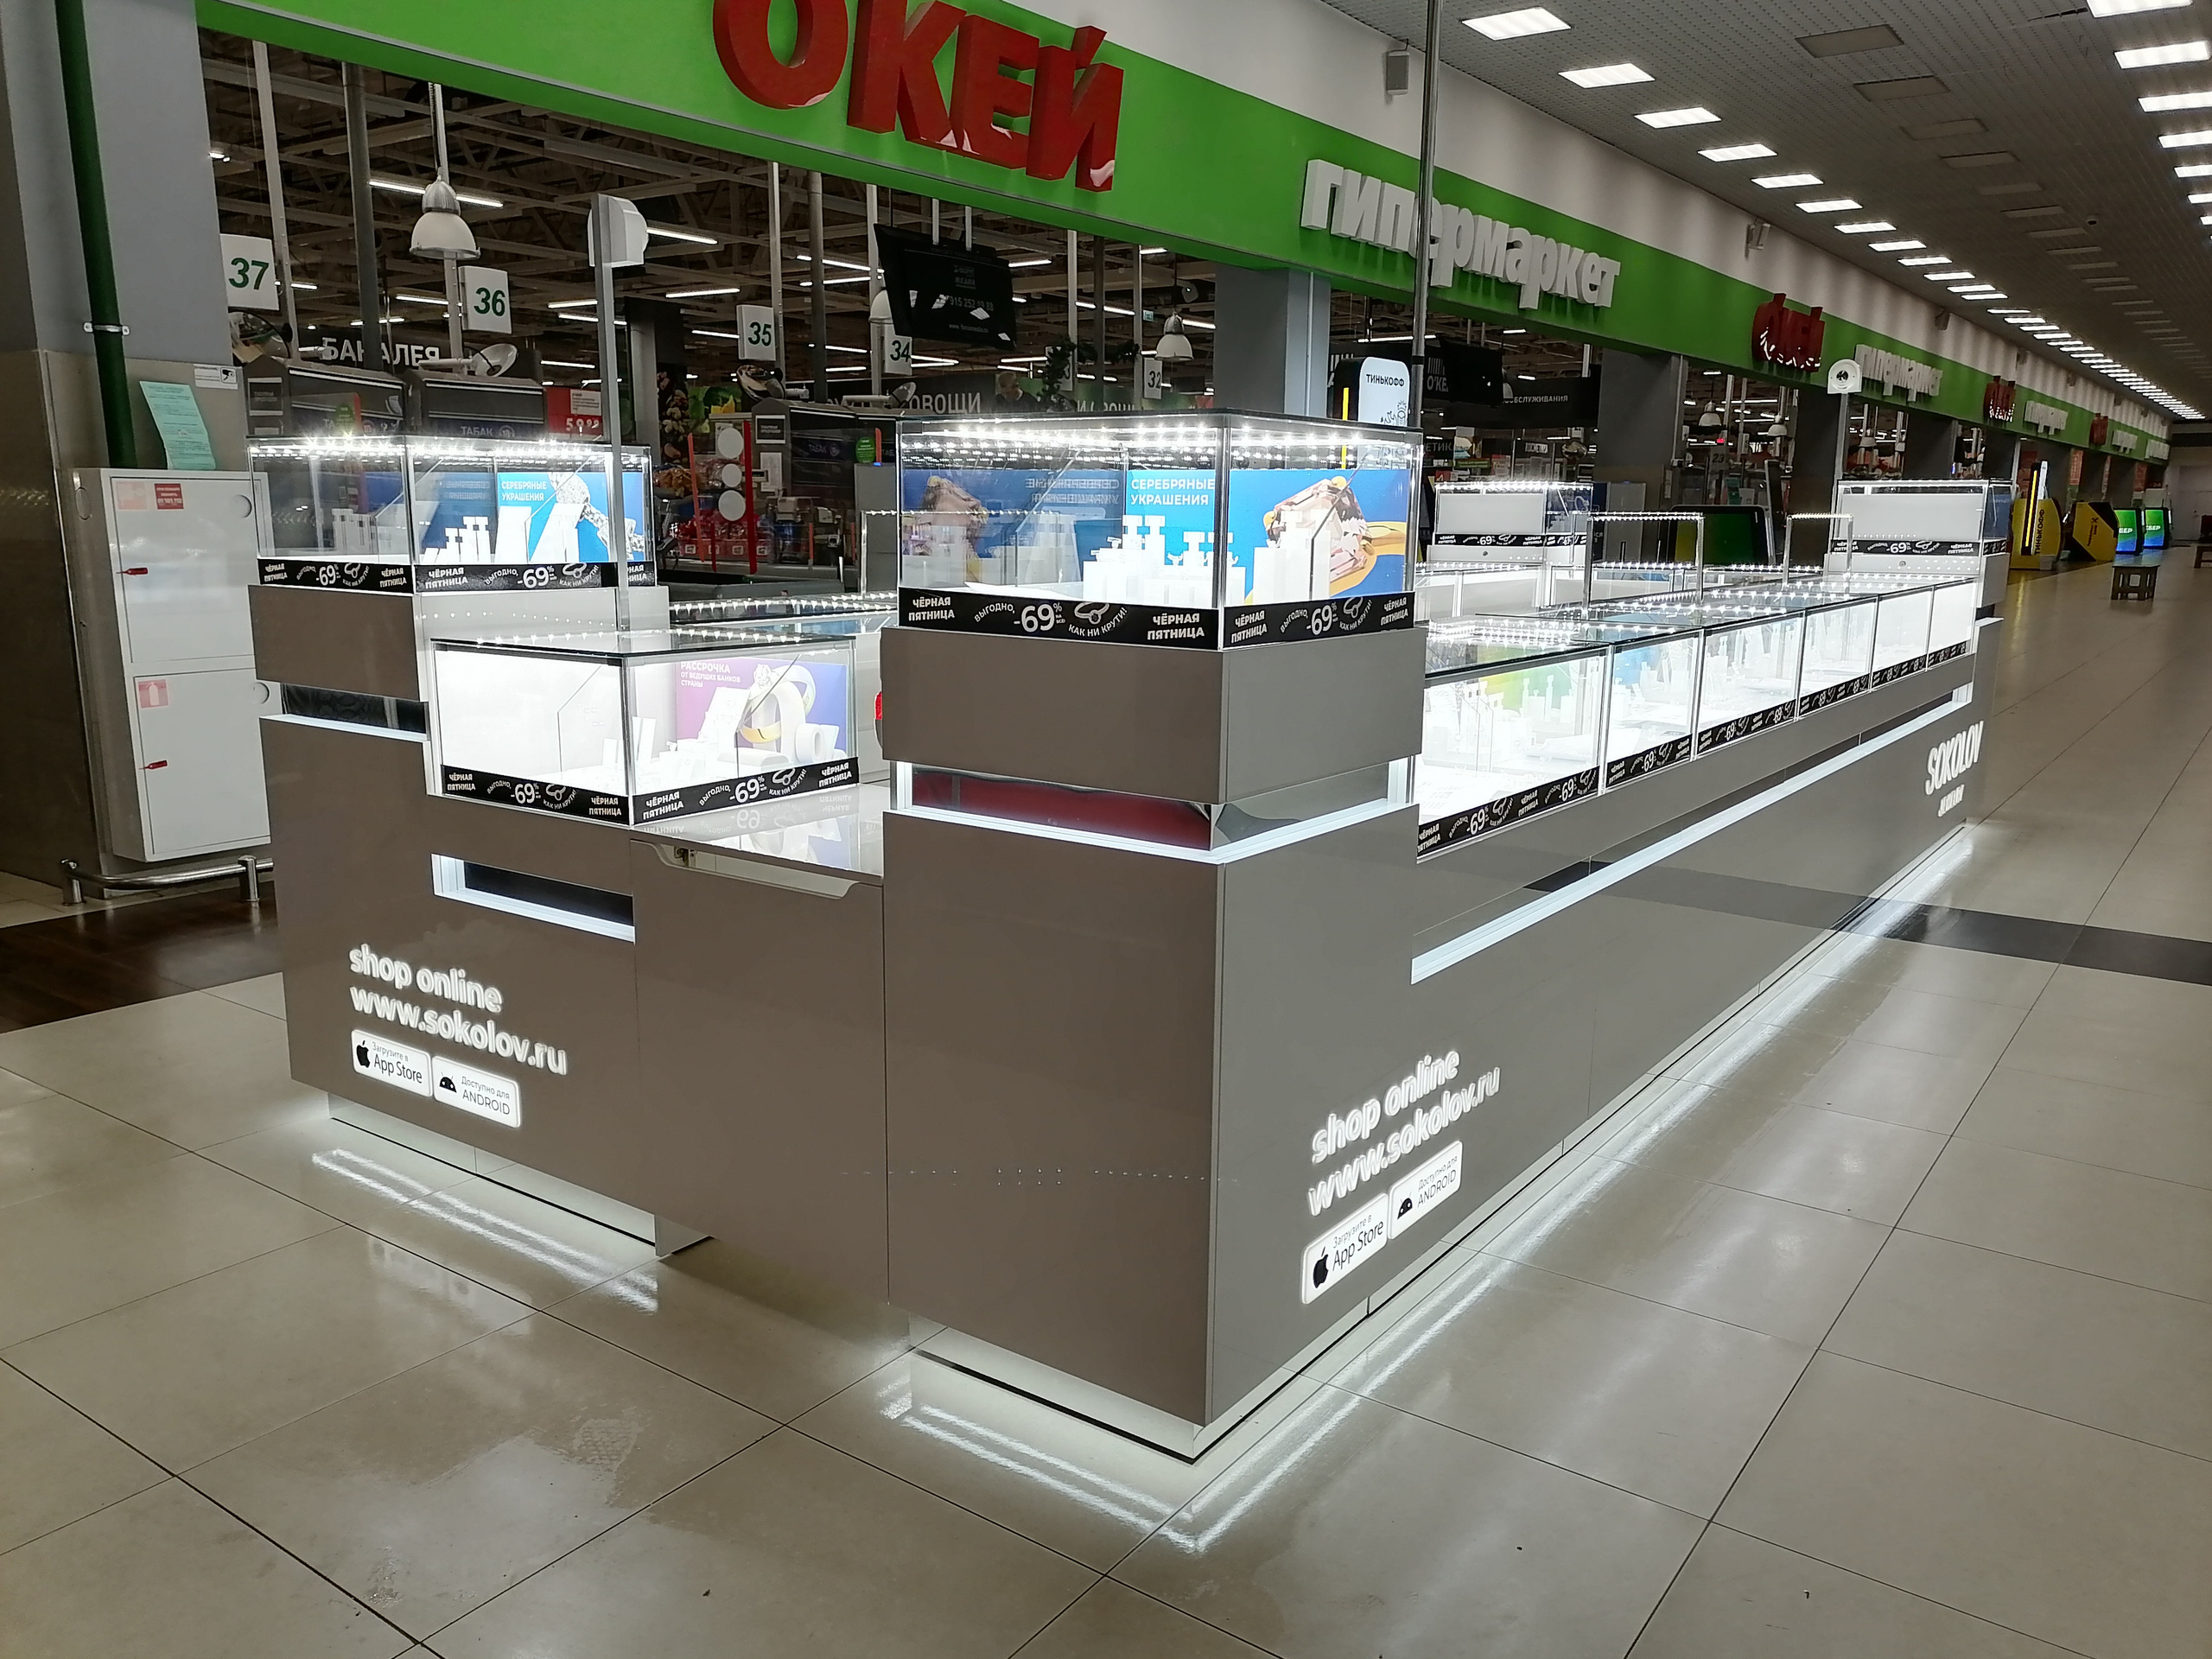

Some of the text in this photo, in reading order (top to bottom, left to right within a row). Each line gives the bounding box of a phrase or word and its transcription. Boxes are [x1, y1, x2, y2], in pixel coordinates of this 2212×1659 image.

[228, 257, 269, 290] 37
[474, 287, 505, 316] 36
[747, 321, 772, 346] 35
[322, 337, 439, 366] БААЛЕЯ
[890, 340, 911, 362] 34
[1147, 371, 1161, 388] 32
[1366, 373, 1405, 386] ТИНЬКОФФ
[1712, 454, 1725, 463] 23
[501, 480, 547, 490] СЕРЕБРЯНЫЕ
[1131, 478, 1215, 490] СЕРЕБРЯНЫЕ
[501, 492, 544, 501] УКРАШЕНИЯ
[1130, 493, 1209, 505] УКРАШЕНИЯ
[2034, 509, 2045, 555] ТИНЬКОФФ
[429, 567, 464, 578] ЧЁРНАЯ
[425, 576, 468, 589] ПЯТНИЦА
[912, 596, 951, 608] ЧЁРНАЯ
[1383, 596, 1407, 613] ЧЁРНАЯ
[908, 608, 955, 621] ПЯТНИЦА
[1153, 613, 1200, 626] ЧЁРНАЯ
[1235, 610, 1265, 628] ЧЁРНАЯ
[1381, 607, 1408, 626] ПЯТНИЦА
[1069, 623, 1086, 637] КАК
[1087, 628, 1100, 638] НИ
[1147, 626, 1205, 641] ПЯТНИЦА
[1231, 623, 1268, 644] ПЯТНИЦА
[681, 662, 731, 673] РАССРОЧКА
[681, 679, 703, 688] СТРАНЫ
[1925, 721, 1984, 795] SOKOLOV
[448, 772, 473, 781] ЧЁРНАЯ
[821, 762, 849, 777] ЧЁРНАЯ
[447, 782, 476, 791] ПЯТНИЦА
[818, 771, 852, 788] ПЯТНИЦА
[591, 795, 619, 805] ЧЁРНАЯ
[645, 791, 680, 808] ЧЁРНАЯ
[588, 807, 622, 816] ПЯТНИЦА
[643, 802, 684, 820] ПЯТНИЦА
[349, 943, 503, 1013] shop online
[349, 986, 569, 1076] www.sokolov.ru
[372, 1041, 403, 1060] Загрузите
[373, 1054, 423, 1084] App Store
[461, 1076, 510, 1101] Доступно для
[462, 1089, 511, 1116] ANDROID
[1312, 1050, 1460, 1164] shop online
[1307, 1066, 1501, 1217] www.sokolov.ru
[1418, 1155, 1458, 1191] Доступно для
[1417, 1169, 1457, 1208] ANDROID
[1332, 1214, 1372, 1249] Загрузите в
[1332, 1221, 1384, 1272] App Store
